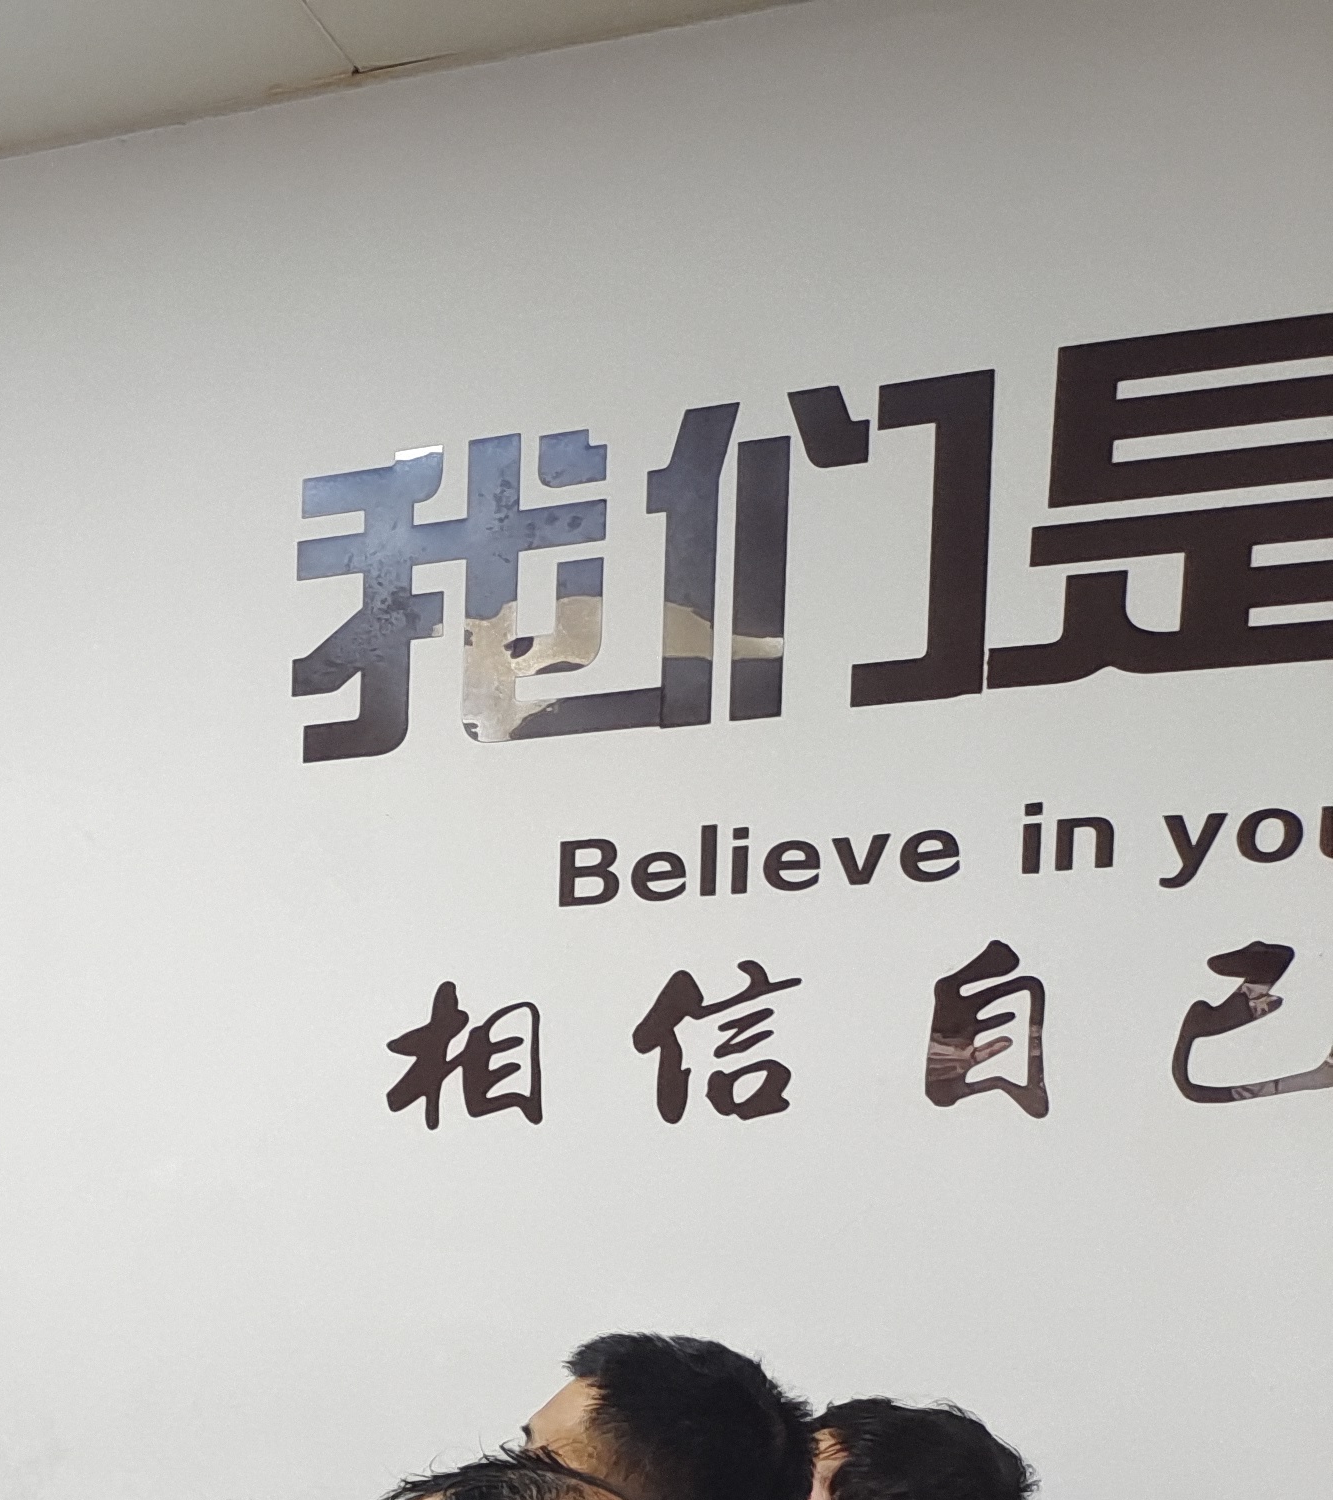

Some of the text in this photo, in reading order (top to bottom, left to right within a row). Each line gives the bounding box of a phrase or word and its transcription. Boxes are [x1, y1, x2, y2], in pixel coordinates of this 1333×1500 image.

[291, 312, 1333, 764] 我们是
[558, 802, 1333, 907] Believe in yo
[386, 939, 1333, 1130] 相信自己
